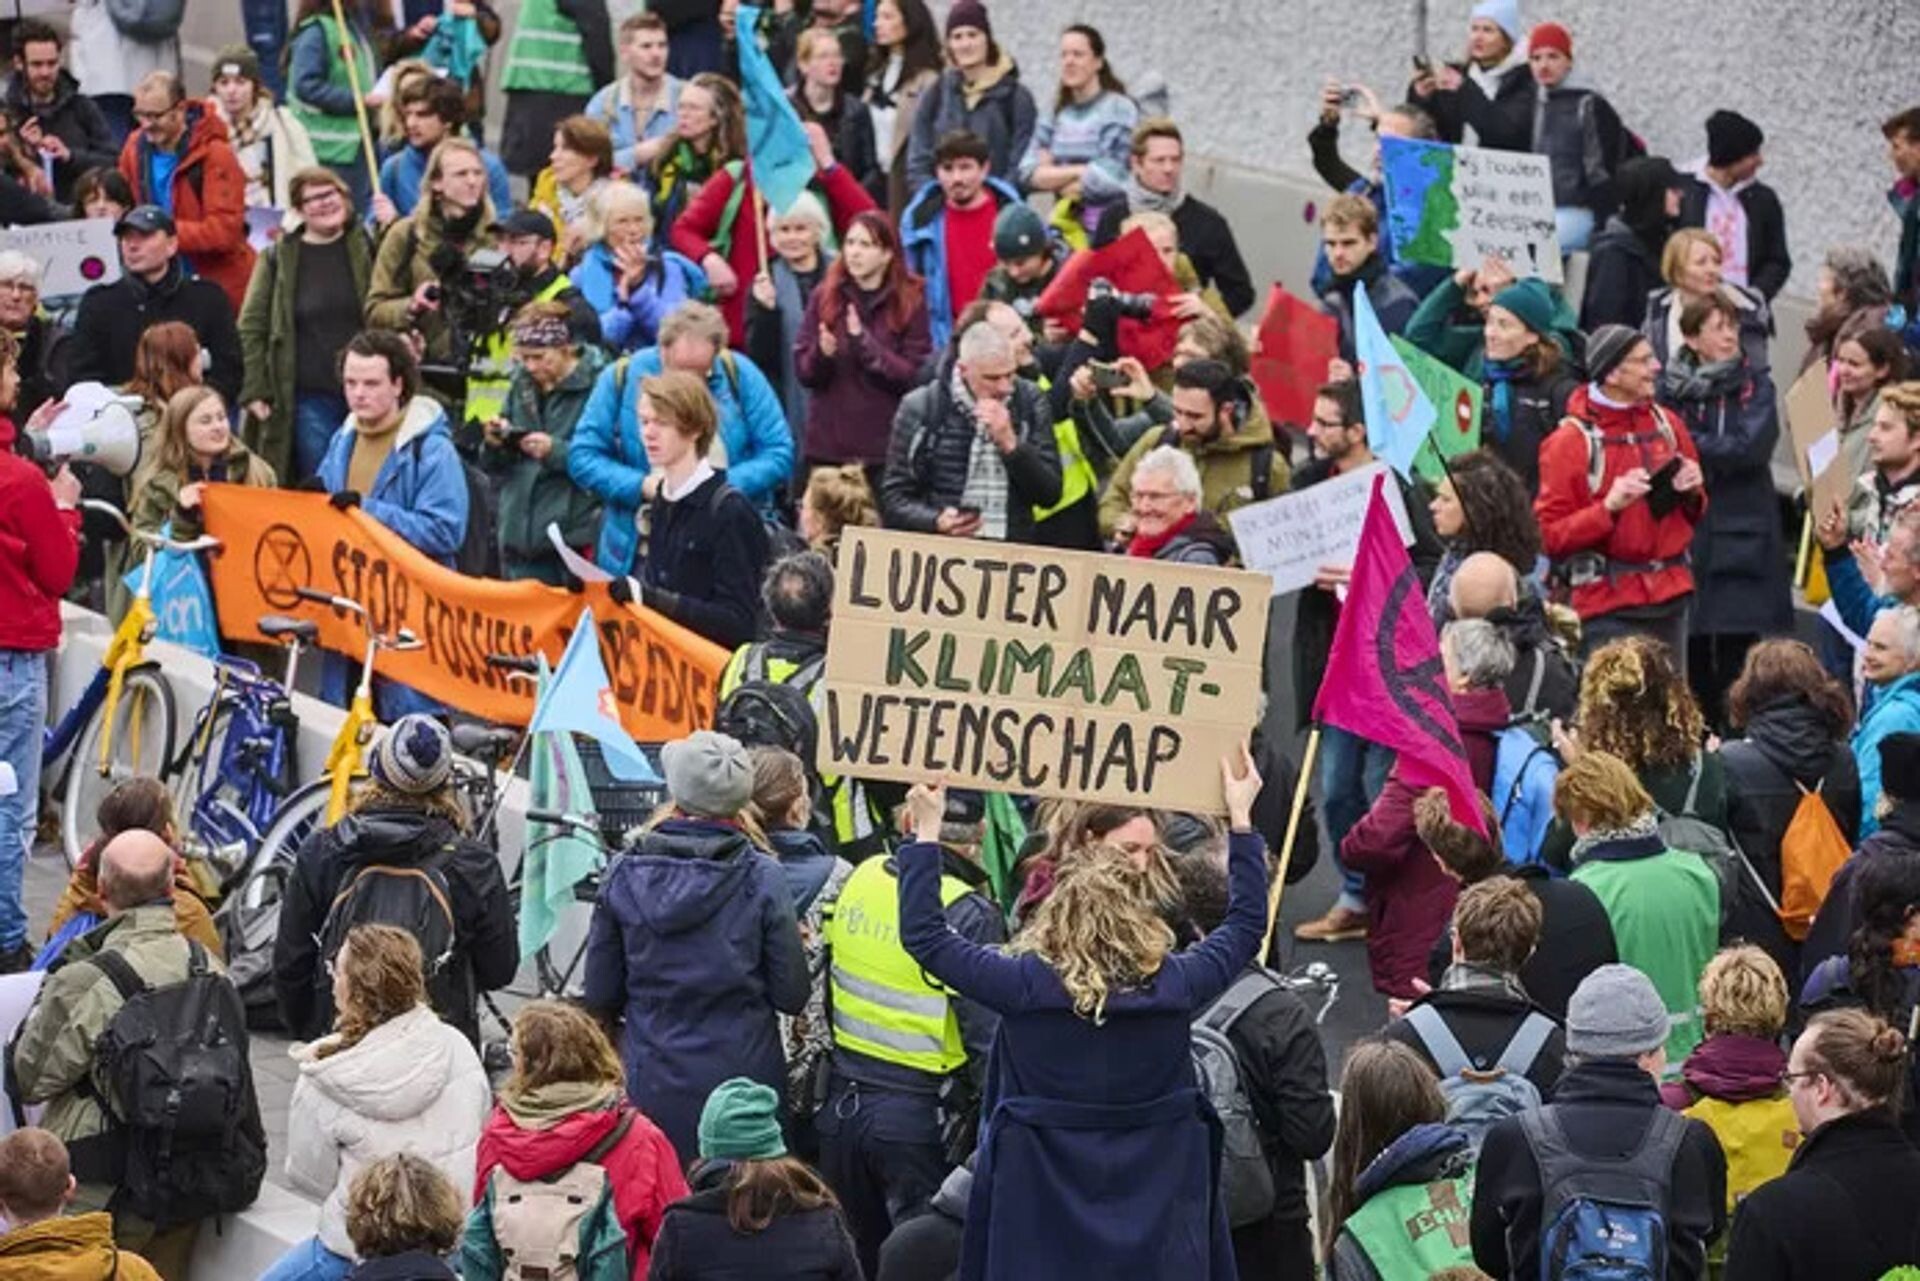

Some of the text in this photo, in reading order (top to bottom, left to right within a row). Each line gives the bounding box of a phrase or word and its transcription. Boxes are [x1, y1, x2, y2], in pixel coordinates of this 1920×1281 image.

[332, 539, 410, 638] STOP
[849, 540, 1241, 653] LUISTER NAAR
[886, 627, 1221, 715] KLIMAAT-
[827, 689, 1181, 793] WETENSCHAP
